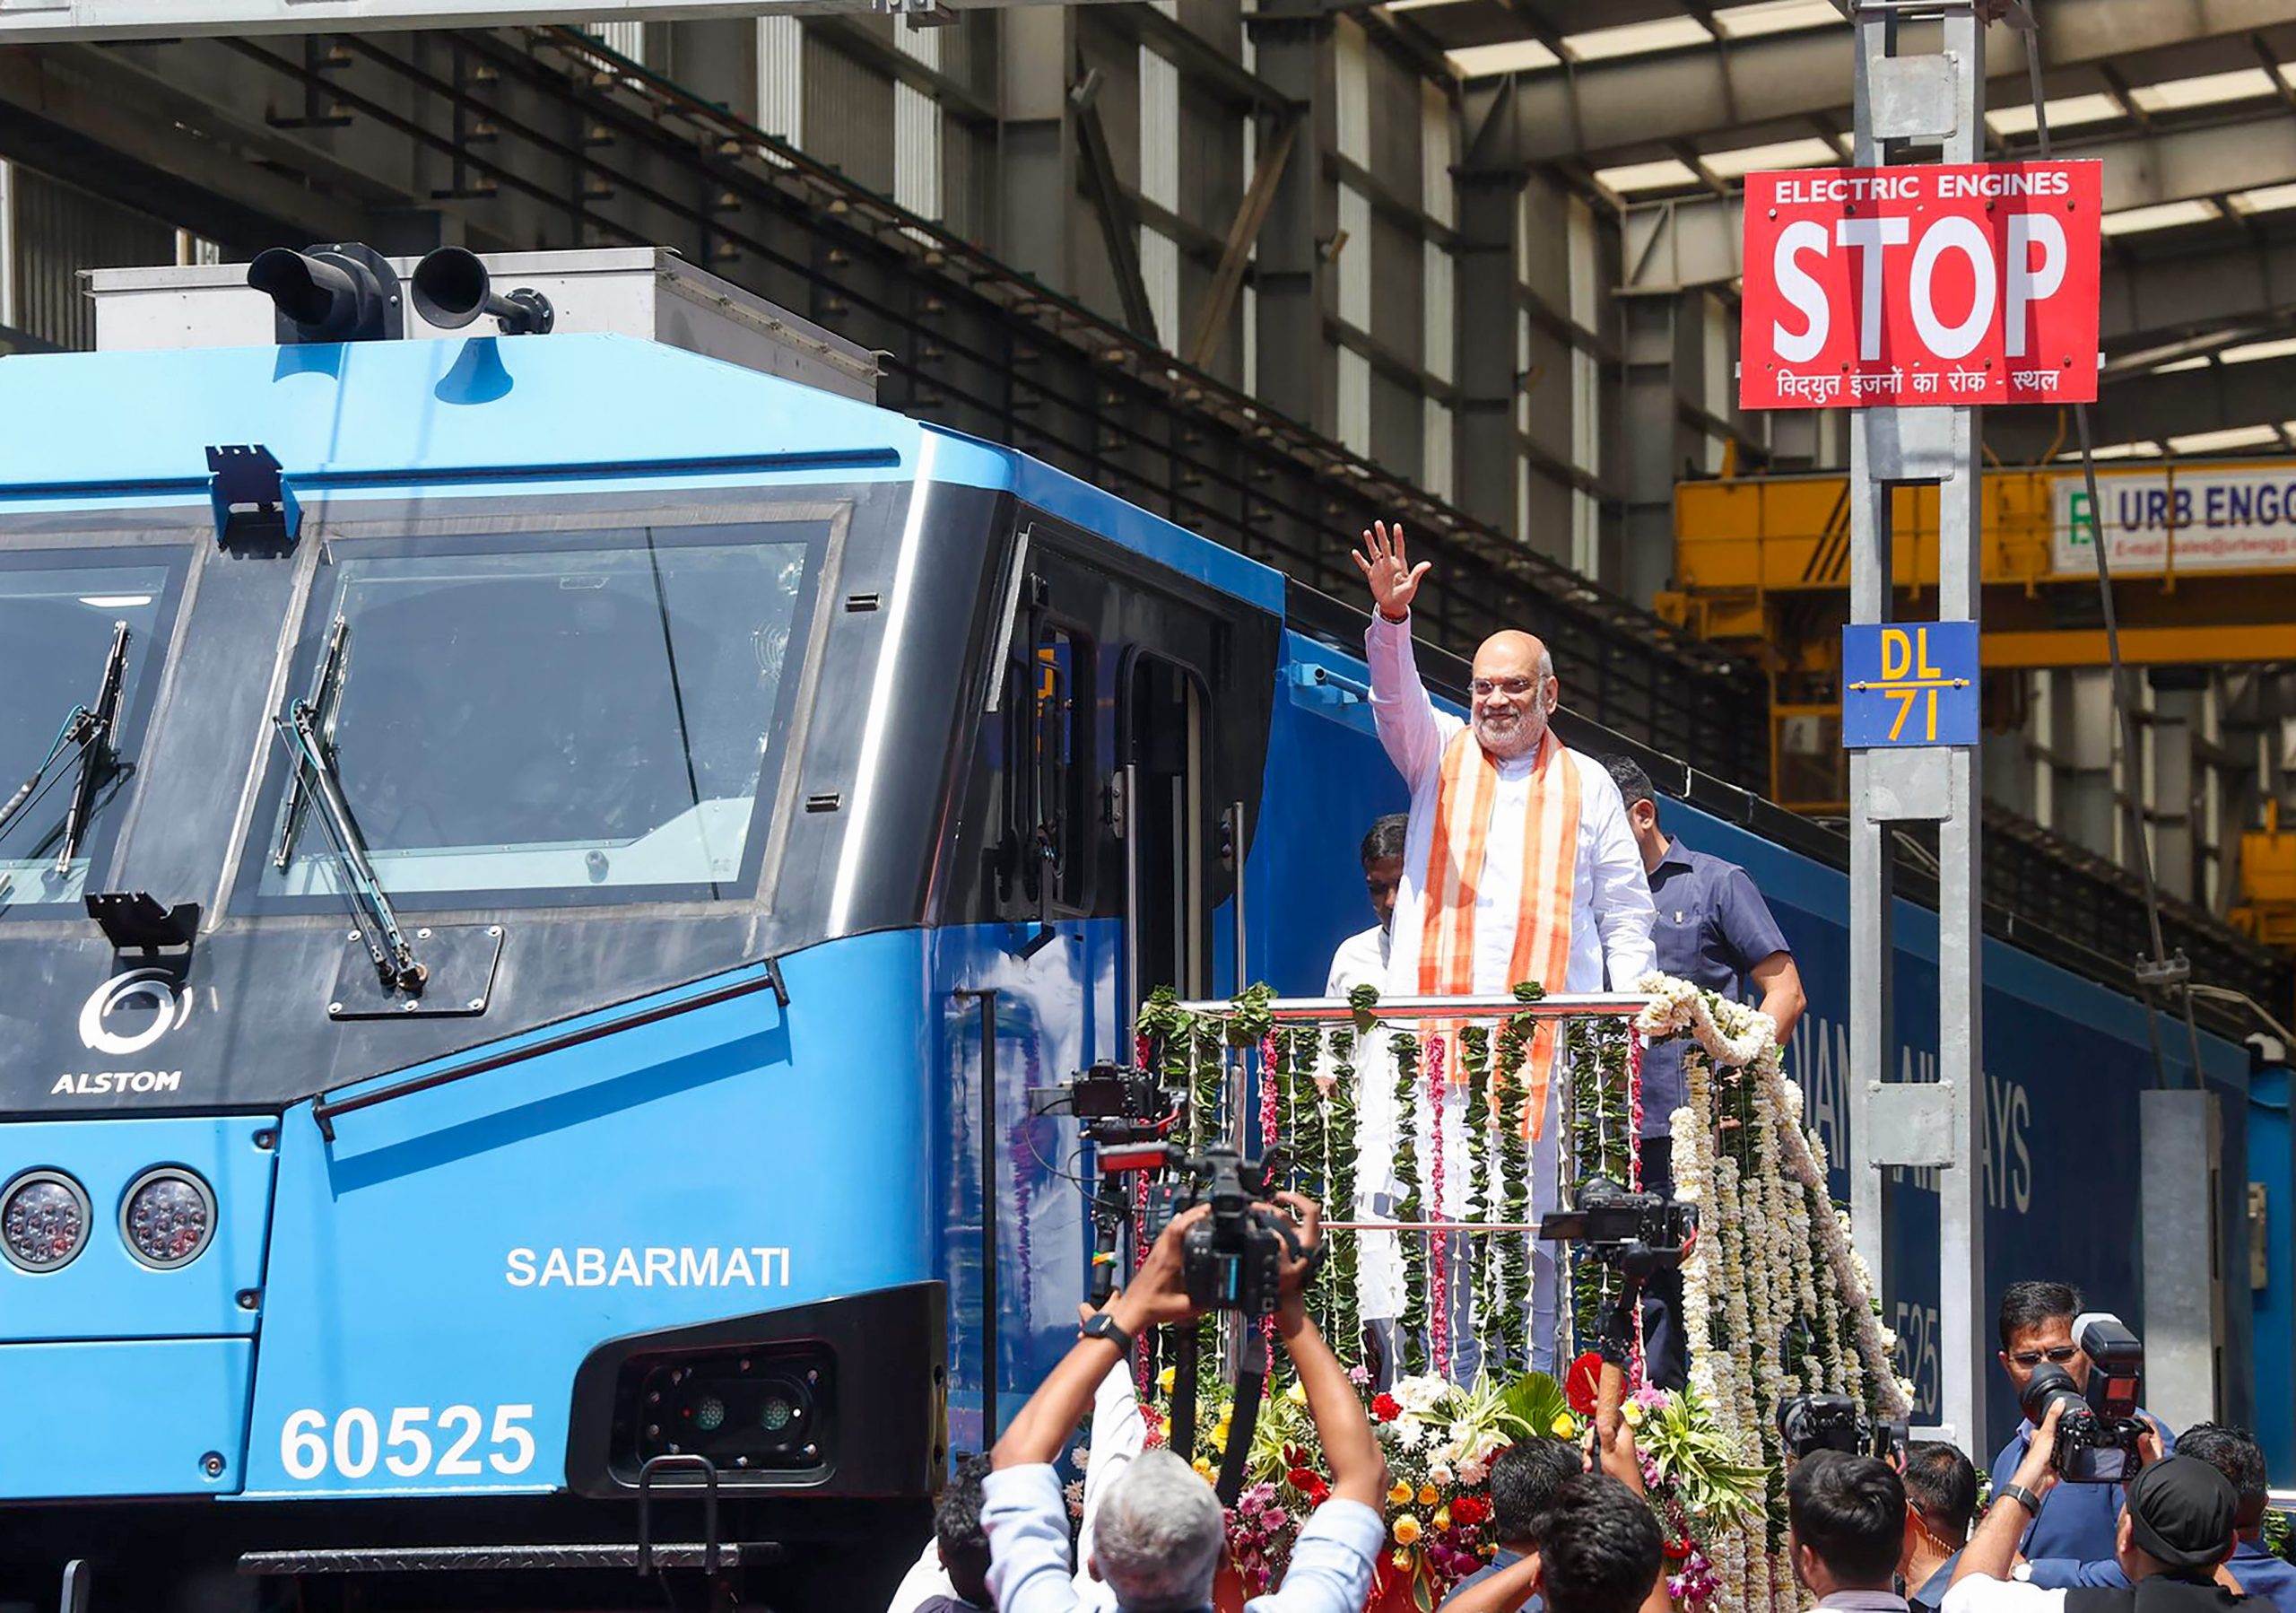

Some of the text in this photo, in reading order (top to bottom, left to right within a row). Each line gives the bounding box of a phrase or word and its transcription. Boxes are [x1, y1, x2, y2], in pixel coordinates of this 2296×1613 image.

[1775, 171, 2069, 204] ELECTRIC ENGINES
[1773, 213, 2067, 363] STOP
[1849, 365, 1903, 395] इंजनों
[1912, 370, 1938, 393] का
[1948, 366, 1987, 393] रोक
[2012, 369, 2061, 391] स्थल
[2118, 489, 2194, 531] URB
[1881, 627, 1942, 680] DL
[1884, 689, 1937, 742] 71
[50, 1070, 182, 1094] ALSTOM
[505, 1247, 789, 1286] SABARMATI
[280, 1404, 536, 1480] 60525
